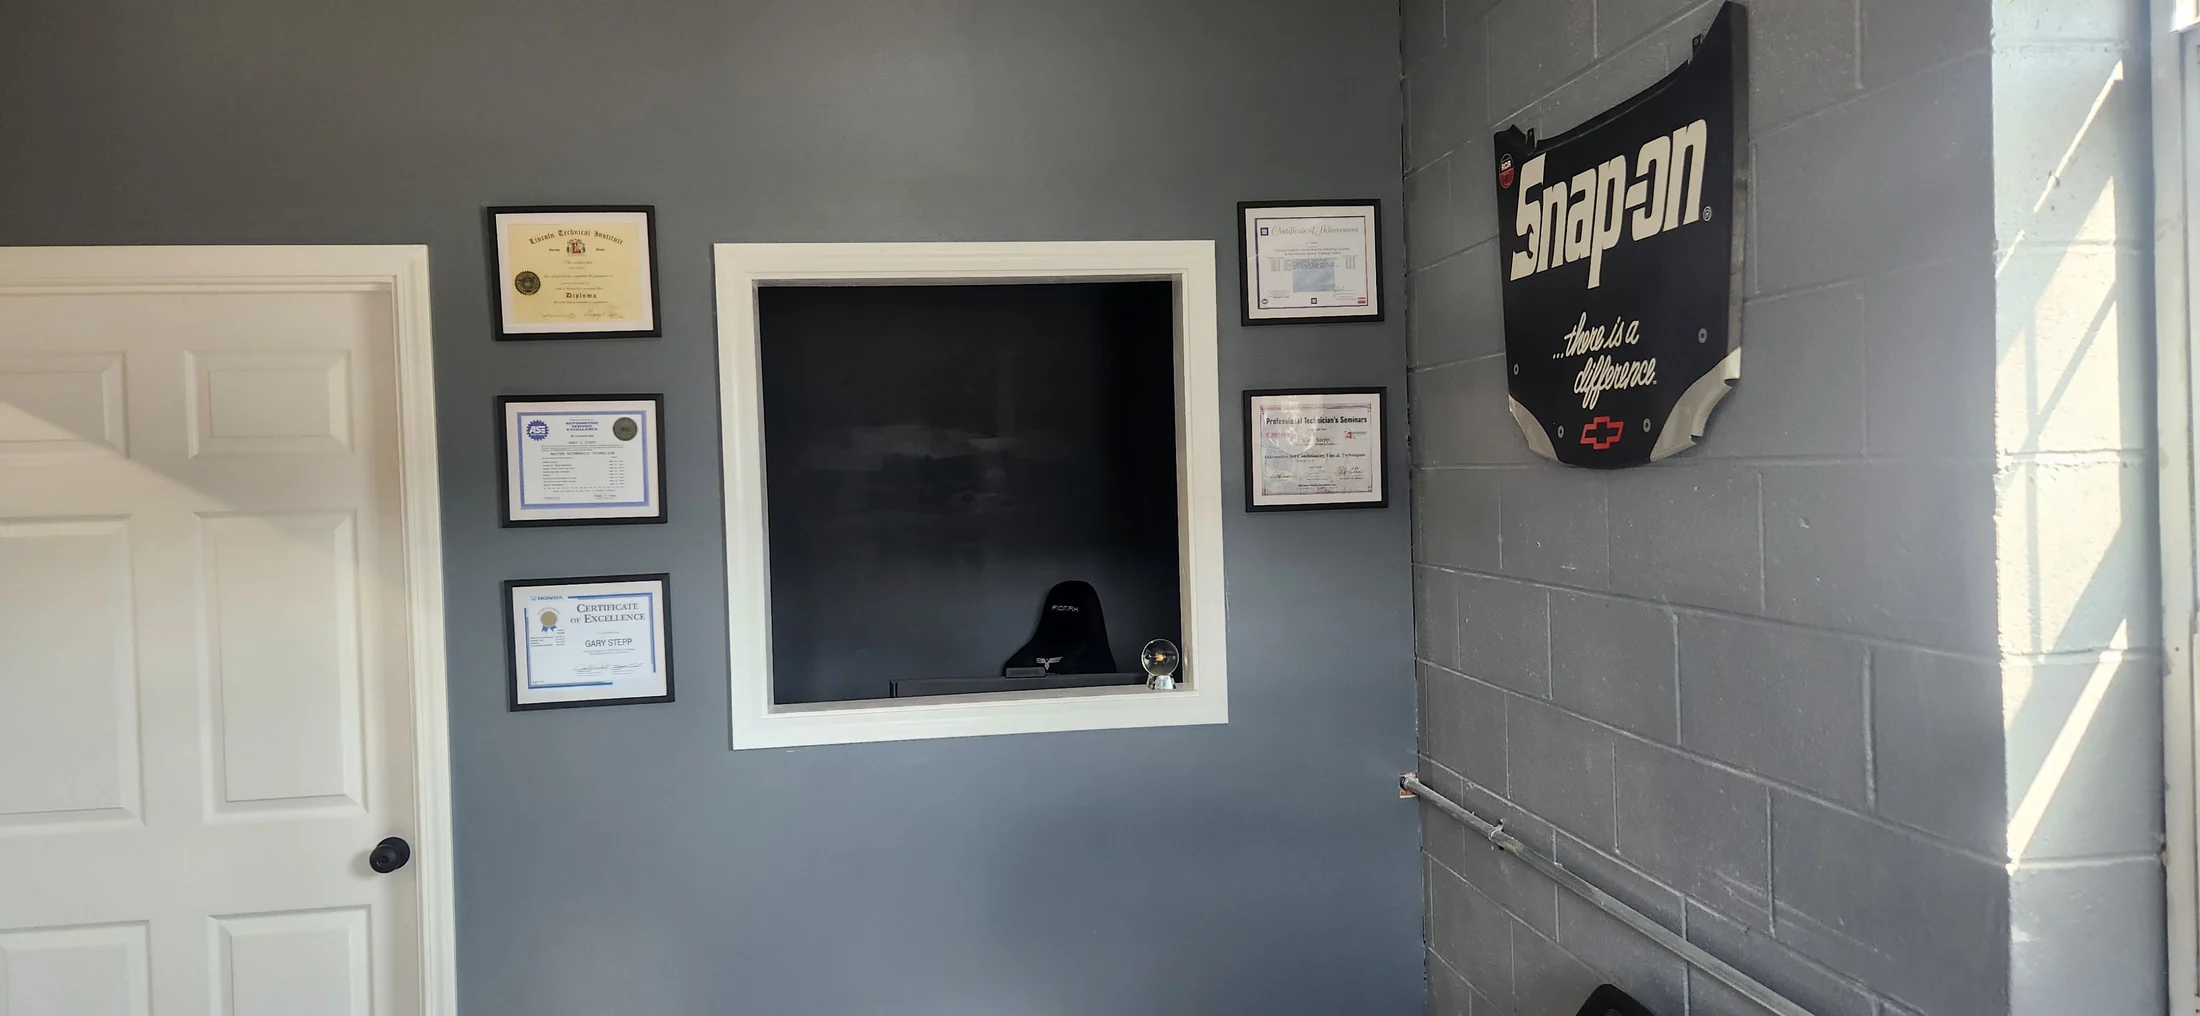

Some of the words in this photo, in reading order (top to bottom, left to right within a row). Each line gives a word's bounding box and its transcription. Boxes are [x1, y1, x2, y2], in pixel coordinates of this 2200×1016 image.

[1510, 119, 1707, 289] Snap-on
[529, 233, 555, 245] Lincoln
[558, 229, 591, 237] Technical
[594, 230, 624, 245] Institute
[1625, 320, 1640, 345] a
[1340, 415, 1367, 424] Seminars
[529, 425, 546, 434] ASE
[584, 639, 607, 648] GARY
[608, 638, 633, 647] STEPP
